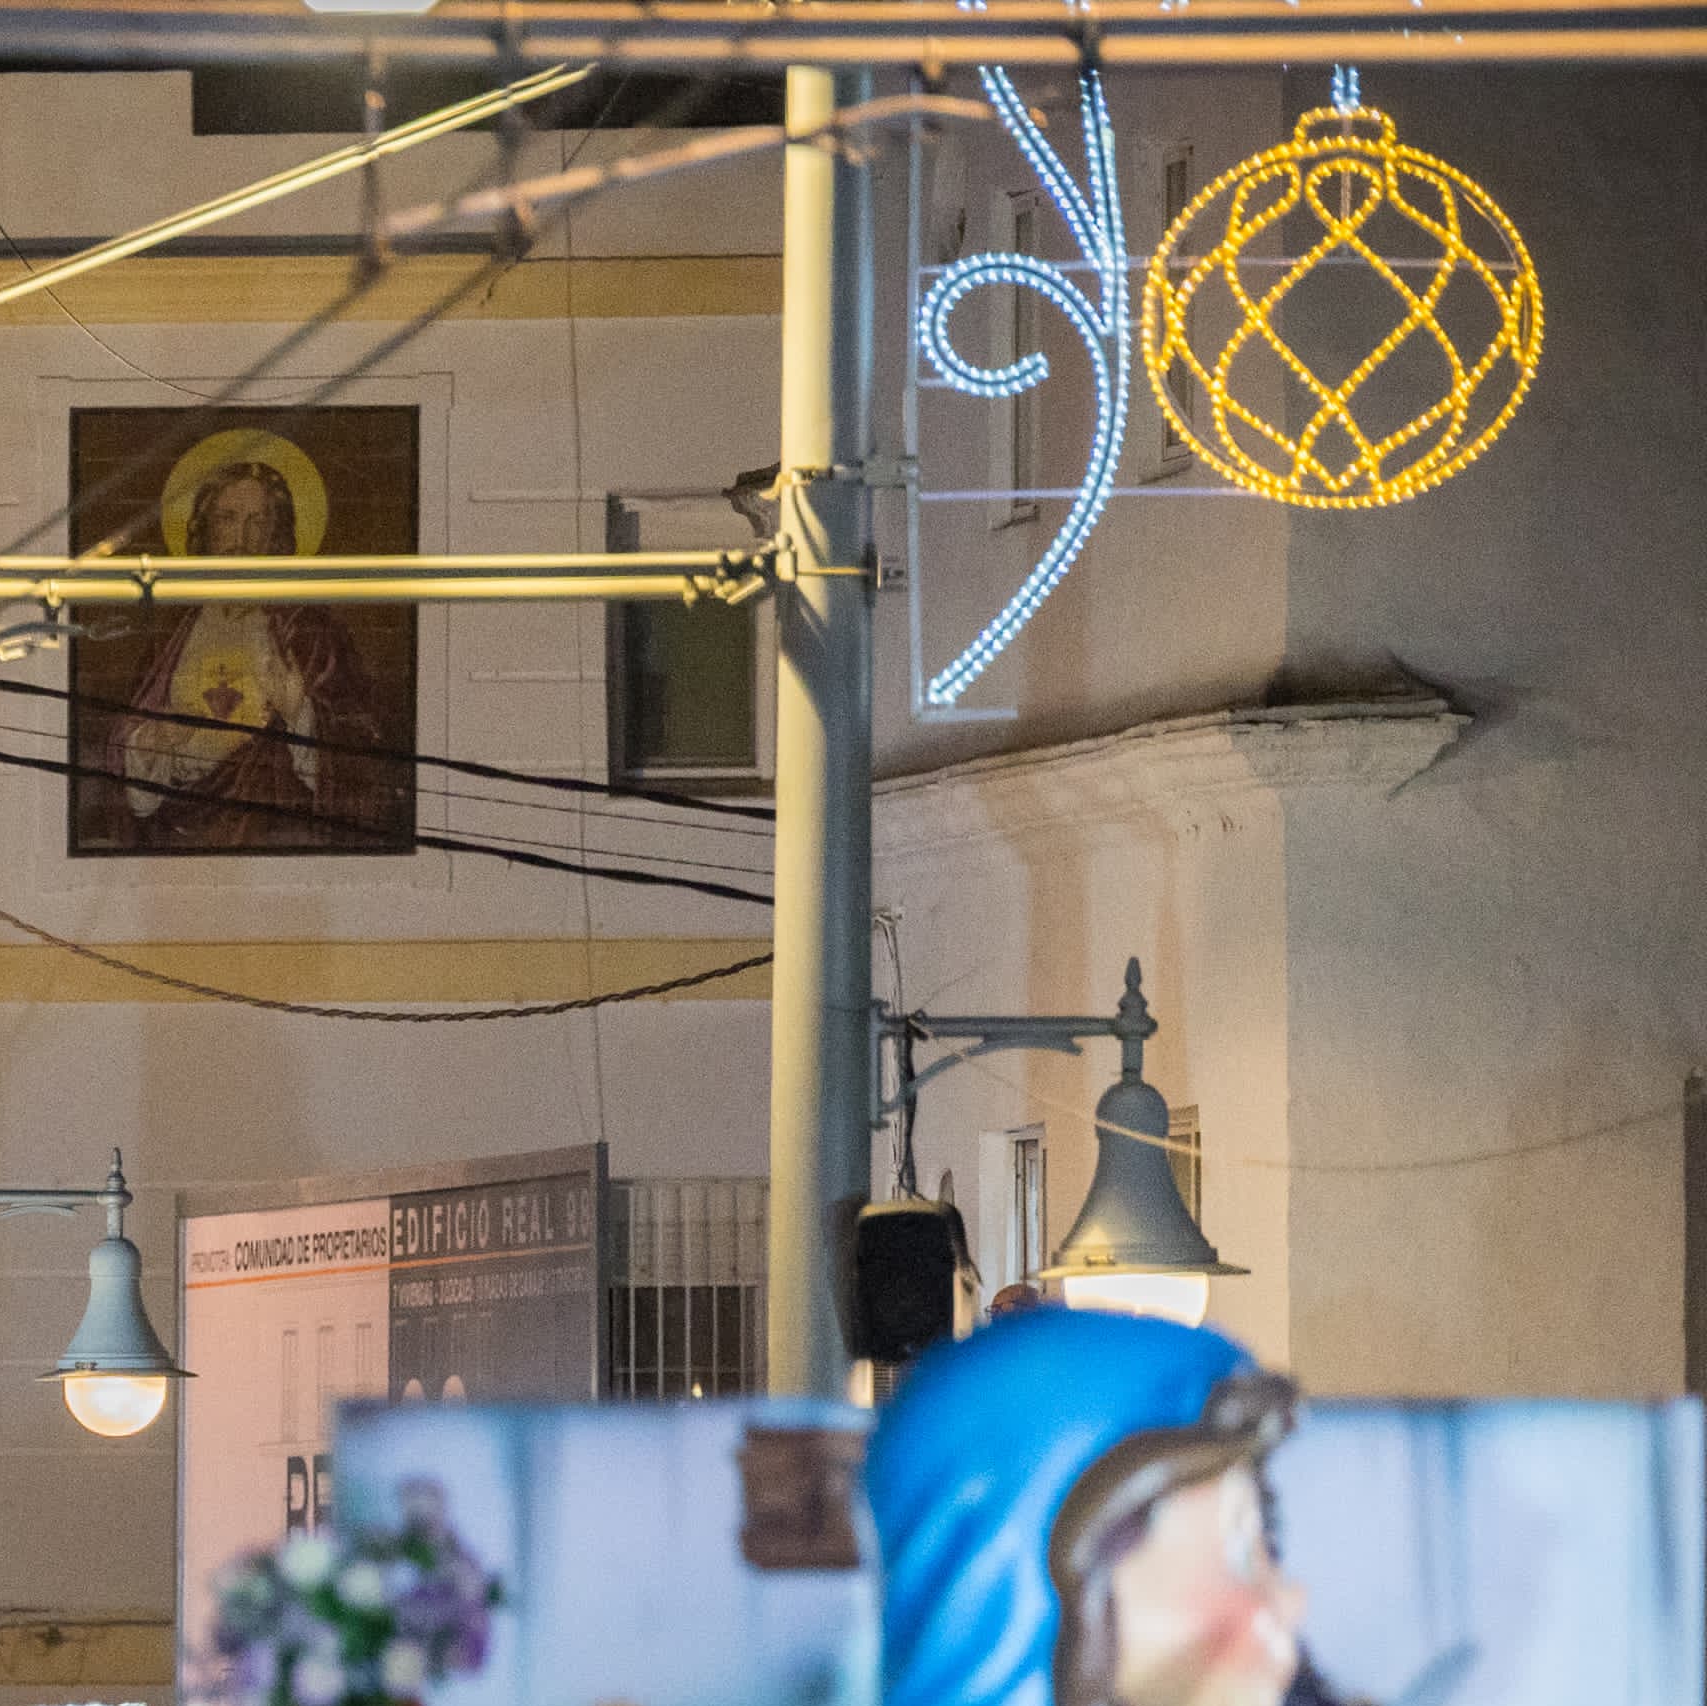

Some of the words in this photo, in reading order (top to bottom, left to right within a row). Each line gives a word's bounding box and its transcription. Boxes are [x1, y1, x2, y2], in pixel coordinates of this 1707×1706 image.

[234, 1236, 294, 1273] COMUNIDAD
[297, 1234, 310, 1265] DE
[312, 1226, 387, 1264] PROPIETARIOS
[392, 1200, 489, 1257] EDIFICIO
[501, 1192, 554, 1245] REAL
